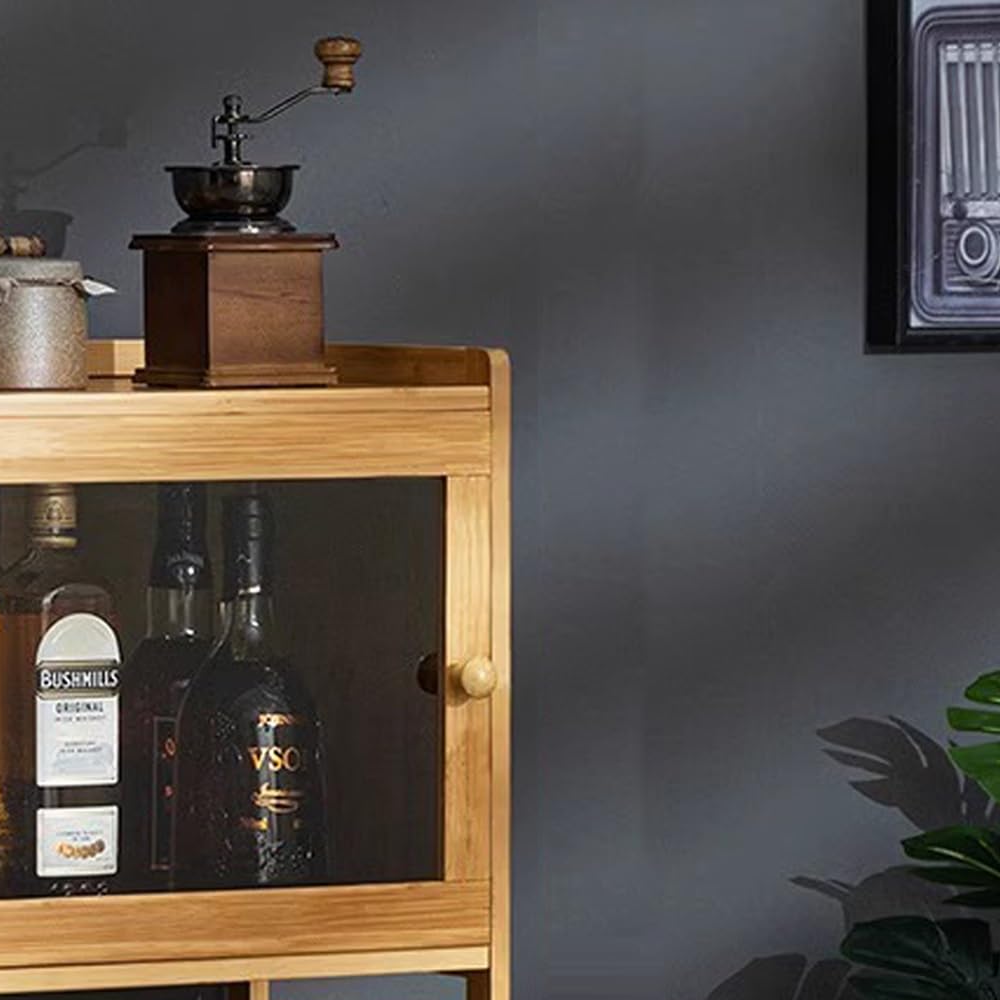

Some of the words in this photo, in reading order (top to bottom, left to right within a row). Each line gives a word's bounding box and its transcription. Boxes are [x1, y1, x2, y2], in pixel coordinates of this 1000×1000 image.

[41, 668, 119, 689] BUSHMILLS
[55, 702, 104, 714] ORIGINAL
[248, 747, 302, 772] VSO
